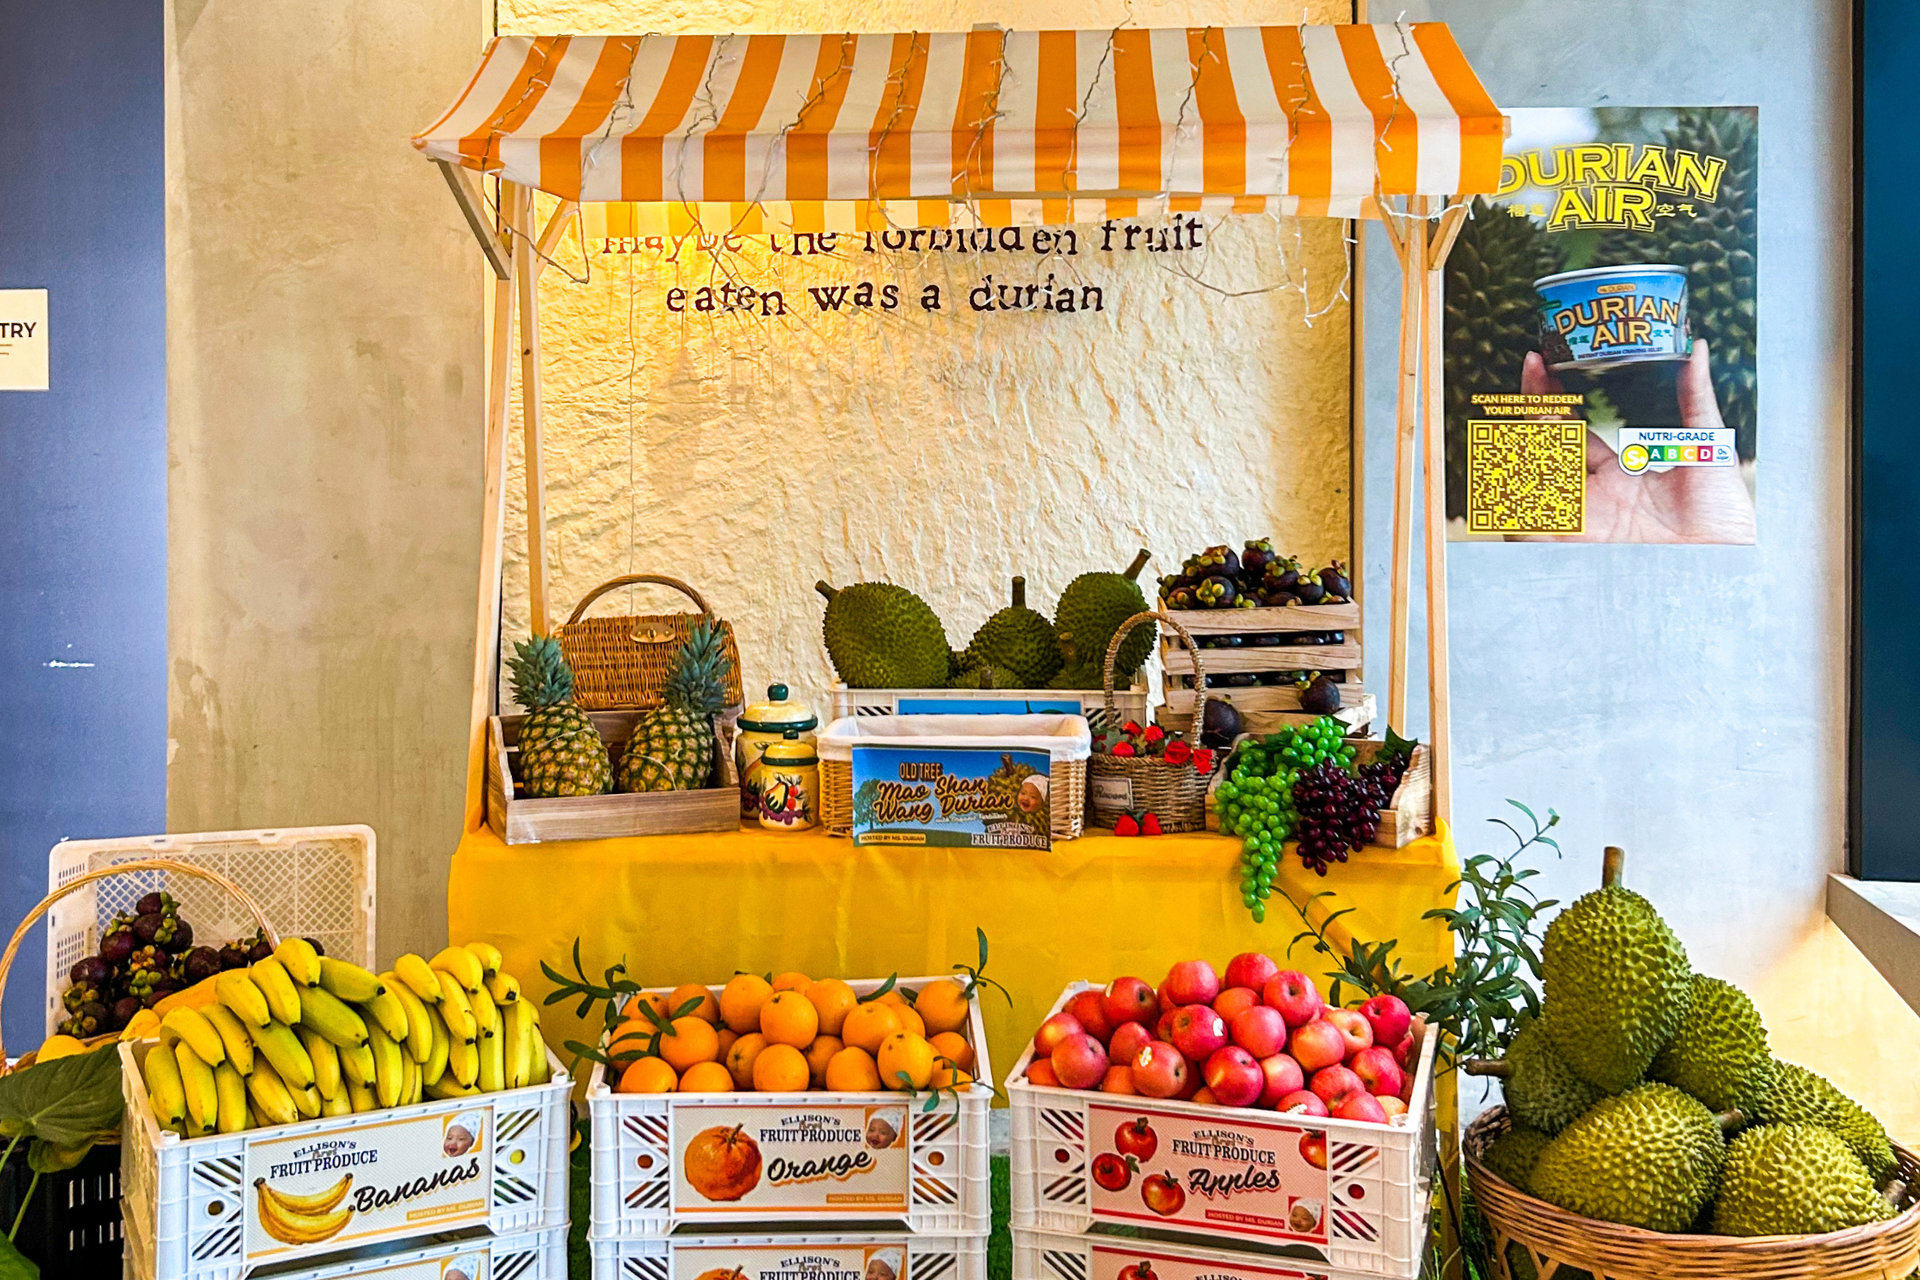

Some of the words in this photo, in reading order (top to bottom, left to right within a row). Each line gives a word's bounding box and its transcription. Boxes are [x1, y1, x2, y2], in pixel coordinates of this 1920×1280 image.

[1488, 142, 1727, 203] DURIAN
[1547, 184, 1657, 233] AIR
[1655, 203, 1697, 218] 空气
[1100, 213, 1204, 252] fruit
[666, 282, 786, 316] eaten
[808, 281, 899, 312] was
[921, 284, 940, 312] a
[969, 273, 1104, 313] durian
[1553, 294, 1680, 335] DURIAN
[1590, 319, 1653, 350] AIR
[1471, 394, 1499, 404] SCAN
[1500, 394, 1526, 404] HERE
[1527, 394, 1541, 404] TO
[1542, 394, 1583, 404] REDEEM
[1483, 405, 1512, 415] YOUR
[1514, 406, 1552, 415] DURIAN
[1553, 406, 1571, 415] AIR
[1638, 432, 1715, 441] NUTRI-GRADE
[1650, 449, 1661, 459] A
[1667, 449, 1677, 459] B
[1684, 449, 1694, 459] C
[1700, 449, 1711, 459] D
[900, 763, 917, 780] OLD
[919, 763, 942, 780] TREE
[878, 782, 929, 801] Mao
[935, 774, 987, 796] Shan
[874, 801, 933, 822] Wang
[940, 793, 1013, 814] Durian
[972, 833, 1000, 846] FRUIT
[1002, 833, 1048, 848] PRODUCE
[781, 1114, 841, 1126] ELLISON'S
[760, 1129, 799, 1142] FRUIT
[800, 1129, 861, 1142] PRODUCE
[1193, 1130, 1255, 1146] ELLISON'S
[293, 1140, 357, 1158] ELLISON'S
[1172, 1139, 1211, 1157] FRUIT
[1214, 1144, 1276, 1165] PRODUCE
[270, 1160, 312, 1179] FRUIT
[314, 1149, 378, 1172] PRODUCE
[767, 1151, 872, 1181] Orange
[353, 1157, 480, 1212] Bananas
[1188, 1164, 1280, 1197] Apples
[1207, 1211, 1235, 1221] HOSTED
[1235, 1214, 1244, 1222] BY
[1257, 1218, 1284, 1228] DURIAN
[780, 1256, 841, 1268] ELLISON'S
[760, 1271, 798, 1280] FRUIT
[800, 1271, 860, 1280] PRODUCE
